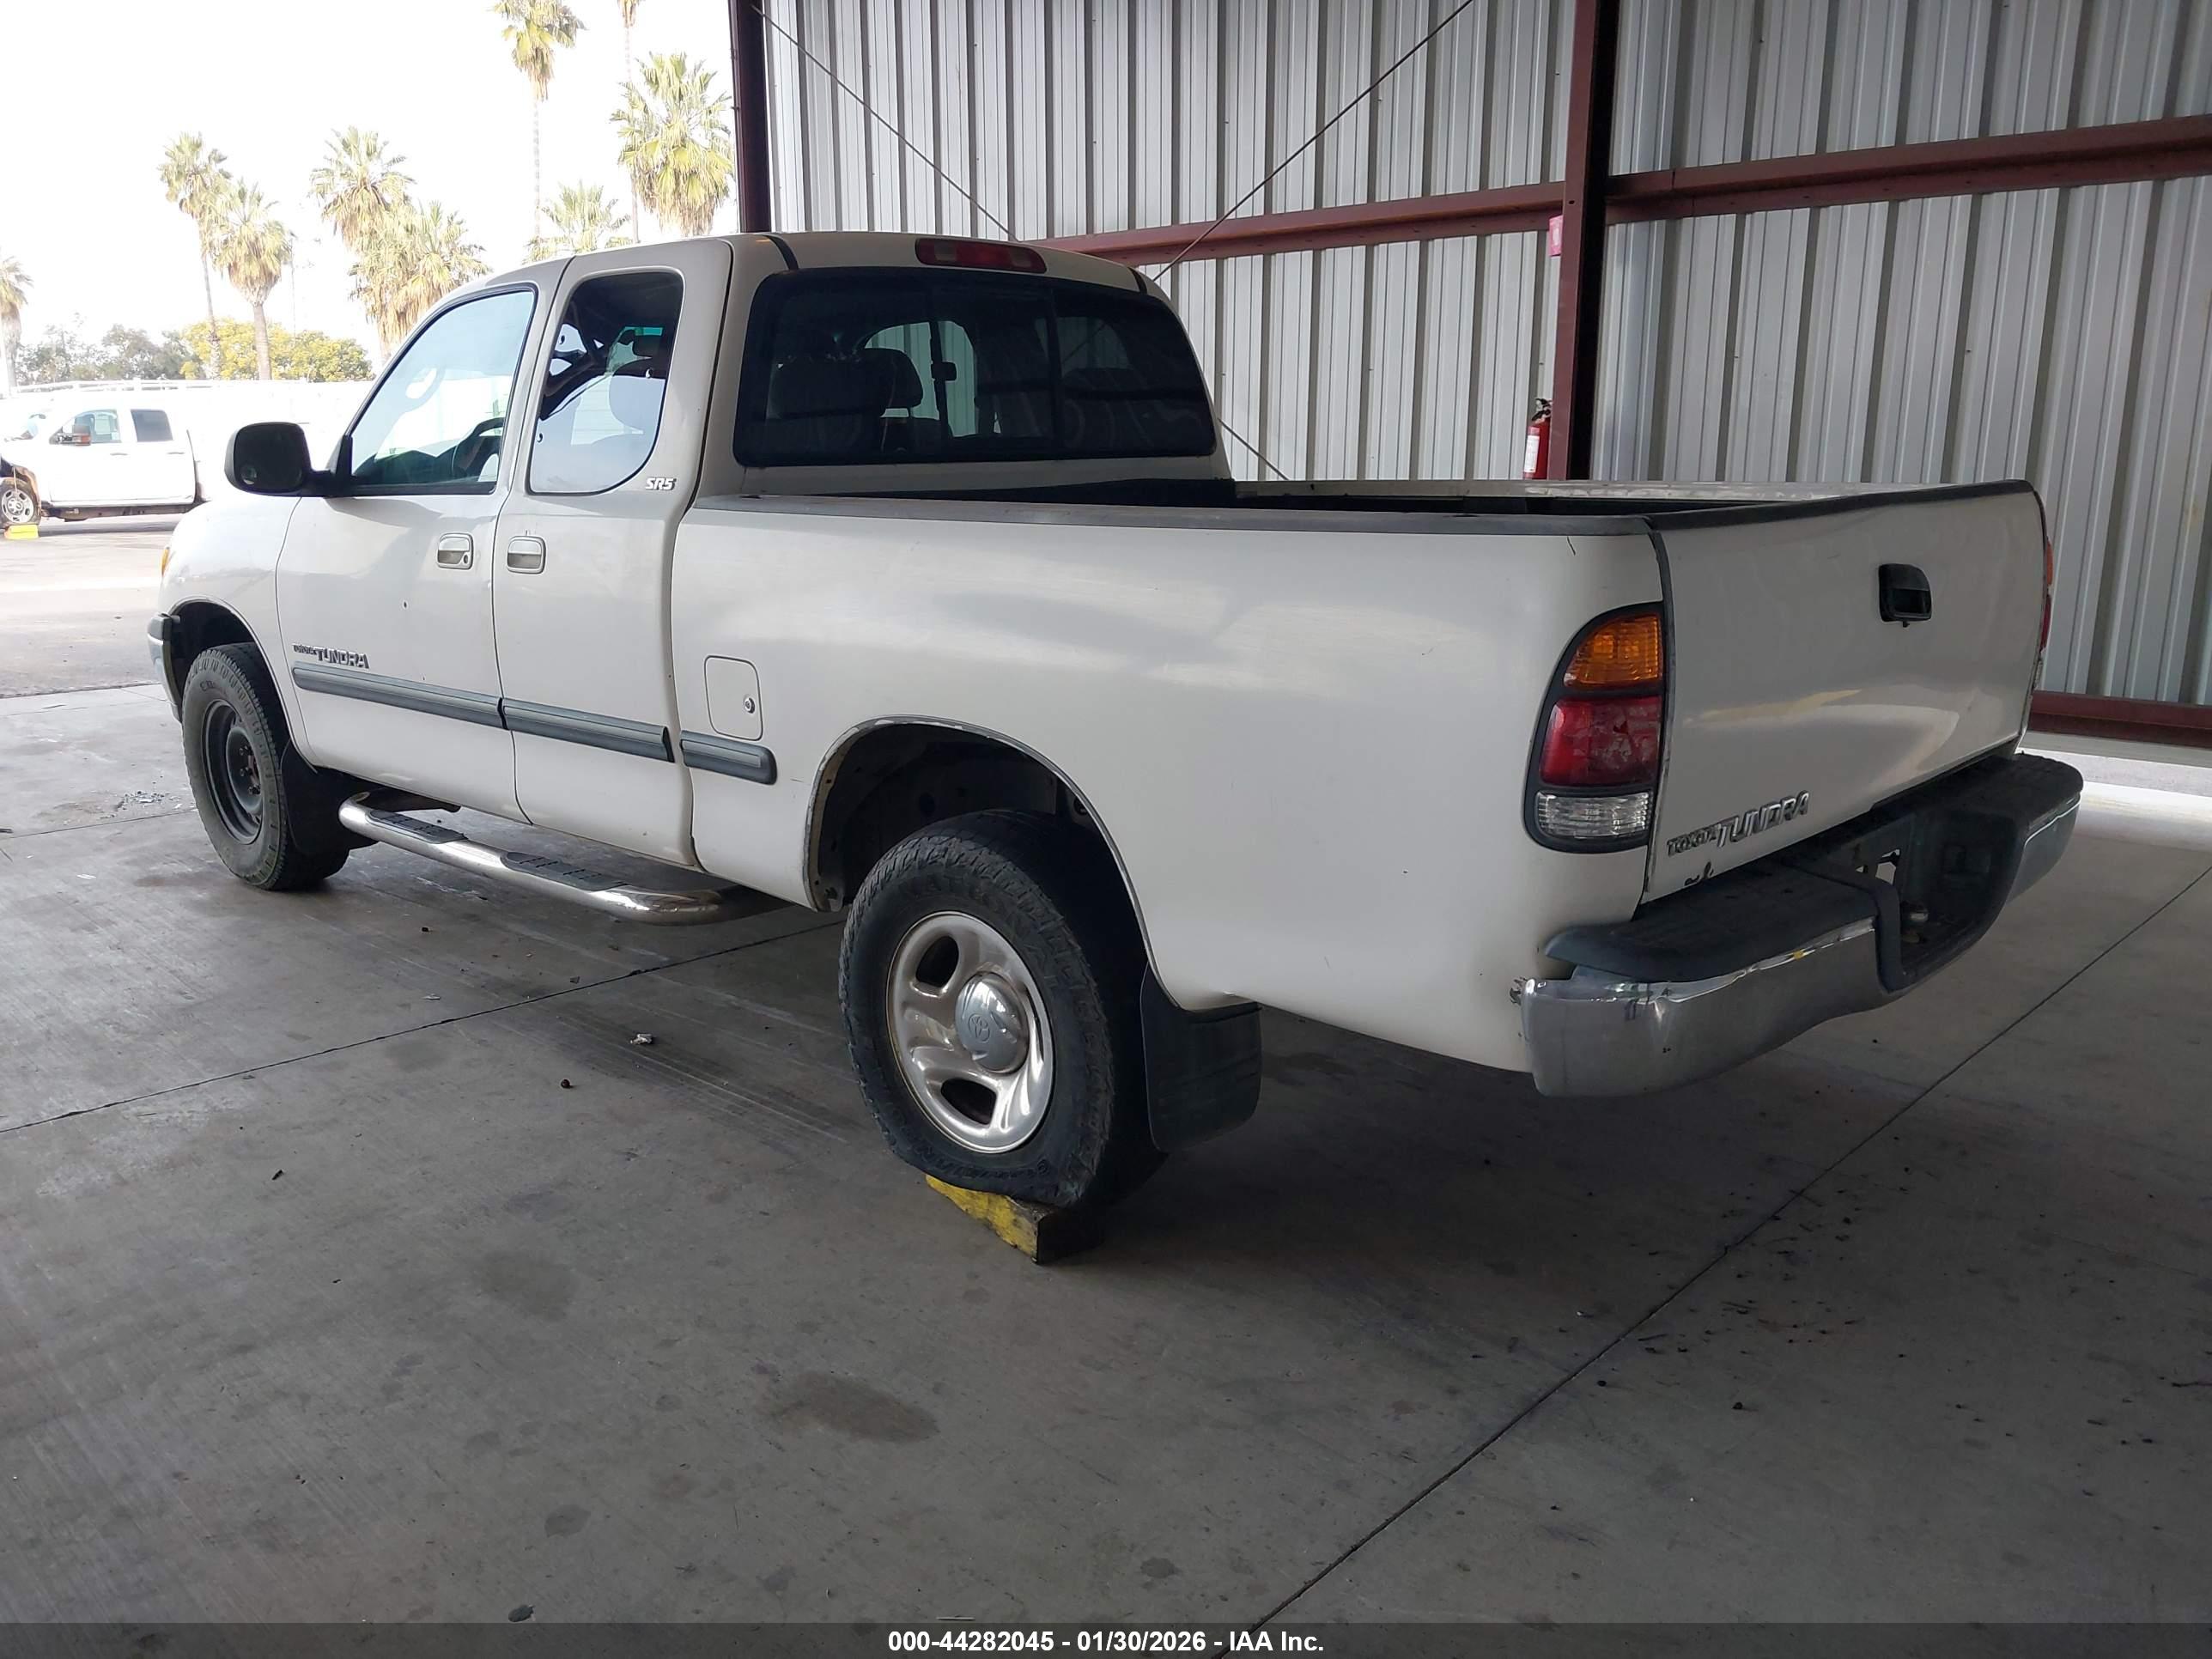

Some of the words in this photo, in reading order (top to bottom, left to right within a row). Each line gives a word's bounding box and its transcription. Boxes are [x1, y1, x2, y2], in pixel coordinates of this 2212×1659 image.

[646, 477, 677, 491] SR5
[315, 647, 369, 669] TUNDRA
[1667, 824, 1718, 857] TOYOTA
[1717, 790, 1809, 848] TUNDRA
